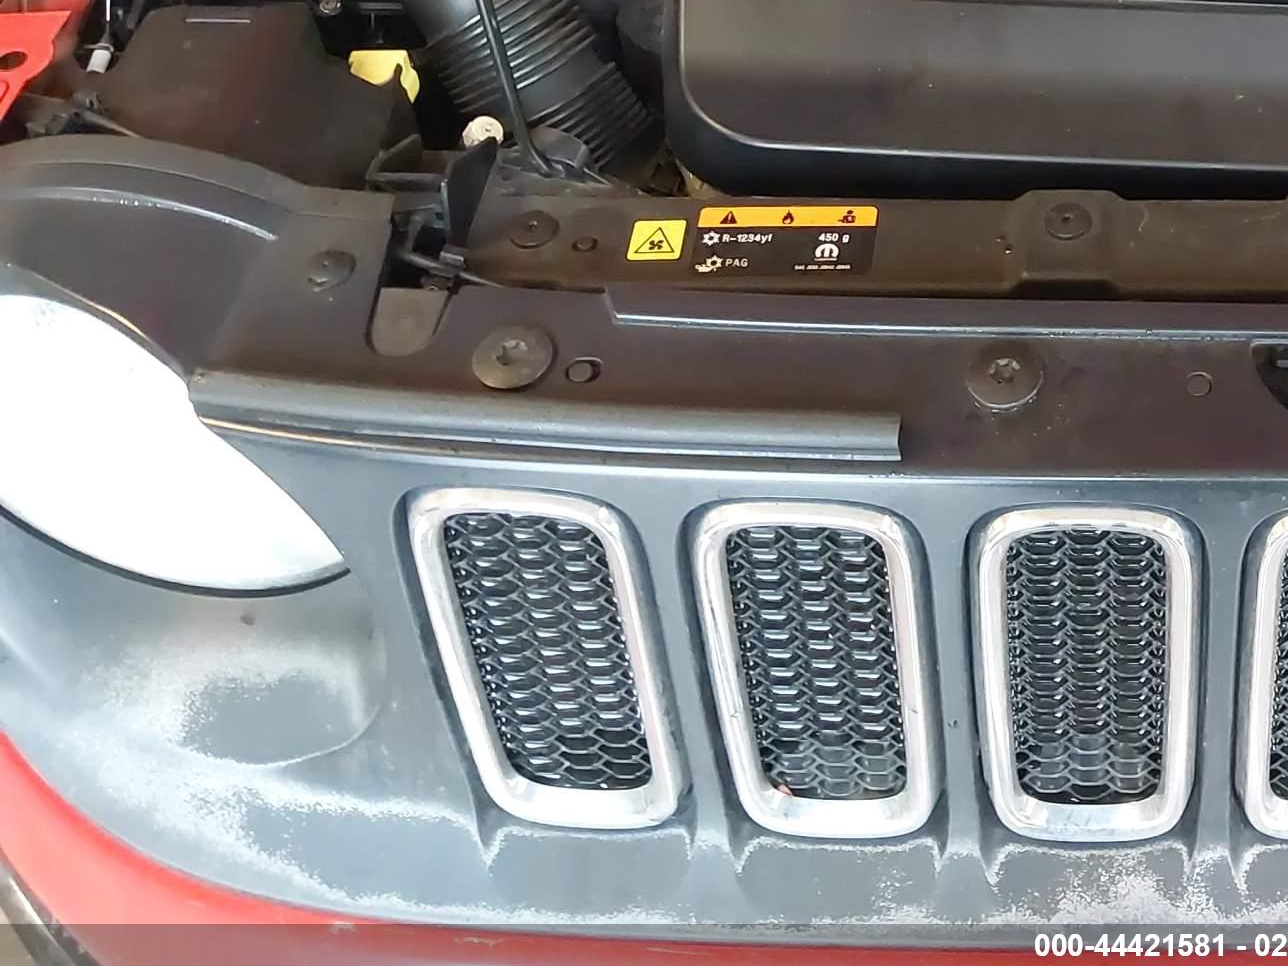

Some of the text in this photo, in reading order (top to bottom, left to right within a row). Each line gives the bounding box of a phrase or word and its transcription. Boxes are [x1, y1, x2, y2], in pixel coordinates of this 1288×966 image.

[722, 233, 850, 244] R-1234yf 450 g
[725, 258, 748, 268] PAG
